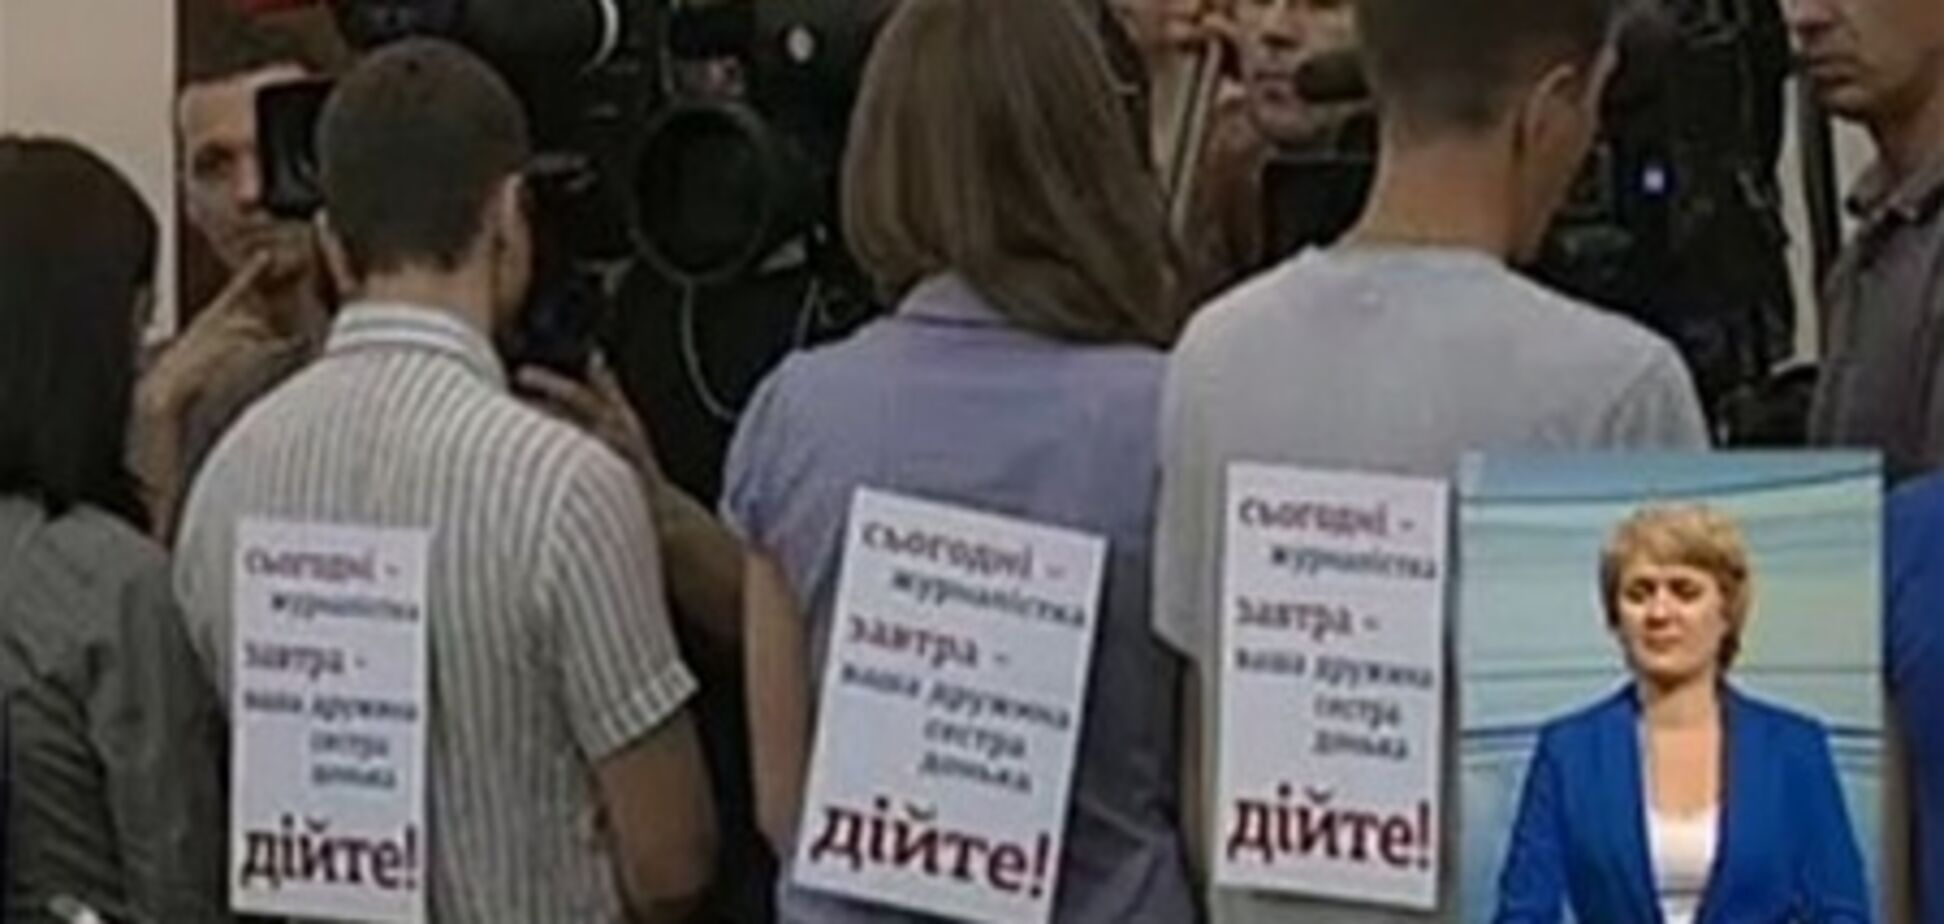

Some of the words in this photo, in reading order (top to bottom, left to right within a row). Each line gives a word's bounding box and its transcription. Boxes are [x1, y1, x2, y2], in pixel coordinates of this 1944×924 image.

[1239, 494, 1389, 538] сьогодні
[862, 521, 1033, 579] сьогодні
[849, 614, 978, 669] завтра
[1236, 595, 1352, 643] завтра
[924, 716, 1027, 759] сестра
[1314, 697, 1401, 731] сестра
[241, 813, 418, 890] дійте!
[810, 796, 1051, 898] дійте!
[1227, 782, 1431, 871] дійте!
